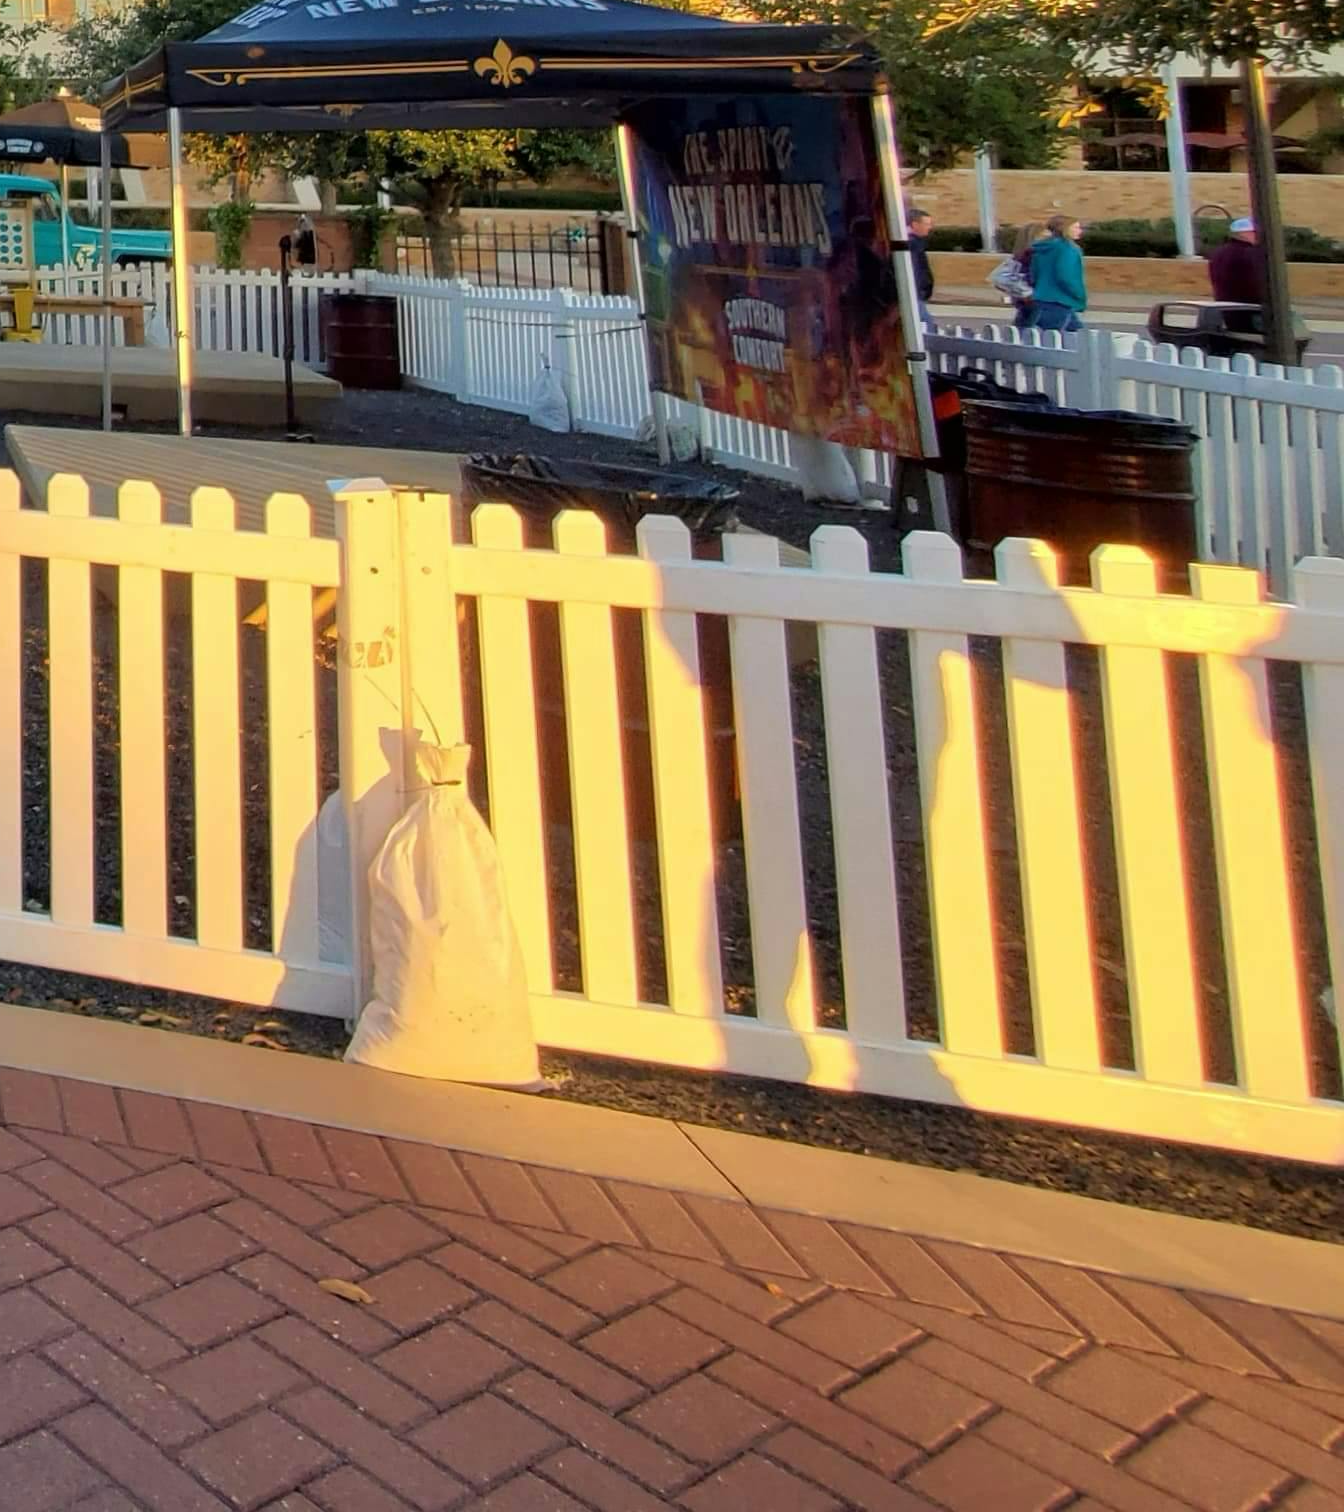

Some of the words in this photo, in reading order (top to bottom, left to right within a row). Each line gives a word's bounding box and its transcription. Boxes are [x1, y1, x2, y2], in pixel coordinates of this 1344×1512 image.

[717, 125, 769, 171] SPIRIT
[668, 184, 718, 249] NEW
[723, 183, 833, 257] ORLEANS
[725, 298, 786, 339] SOUTHERN
[732, 334, 786, 373] COMFORT
